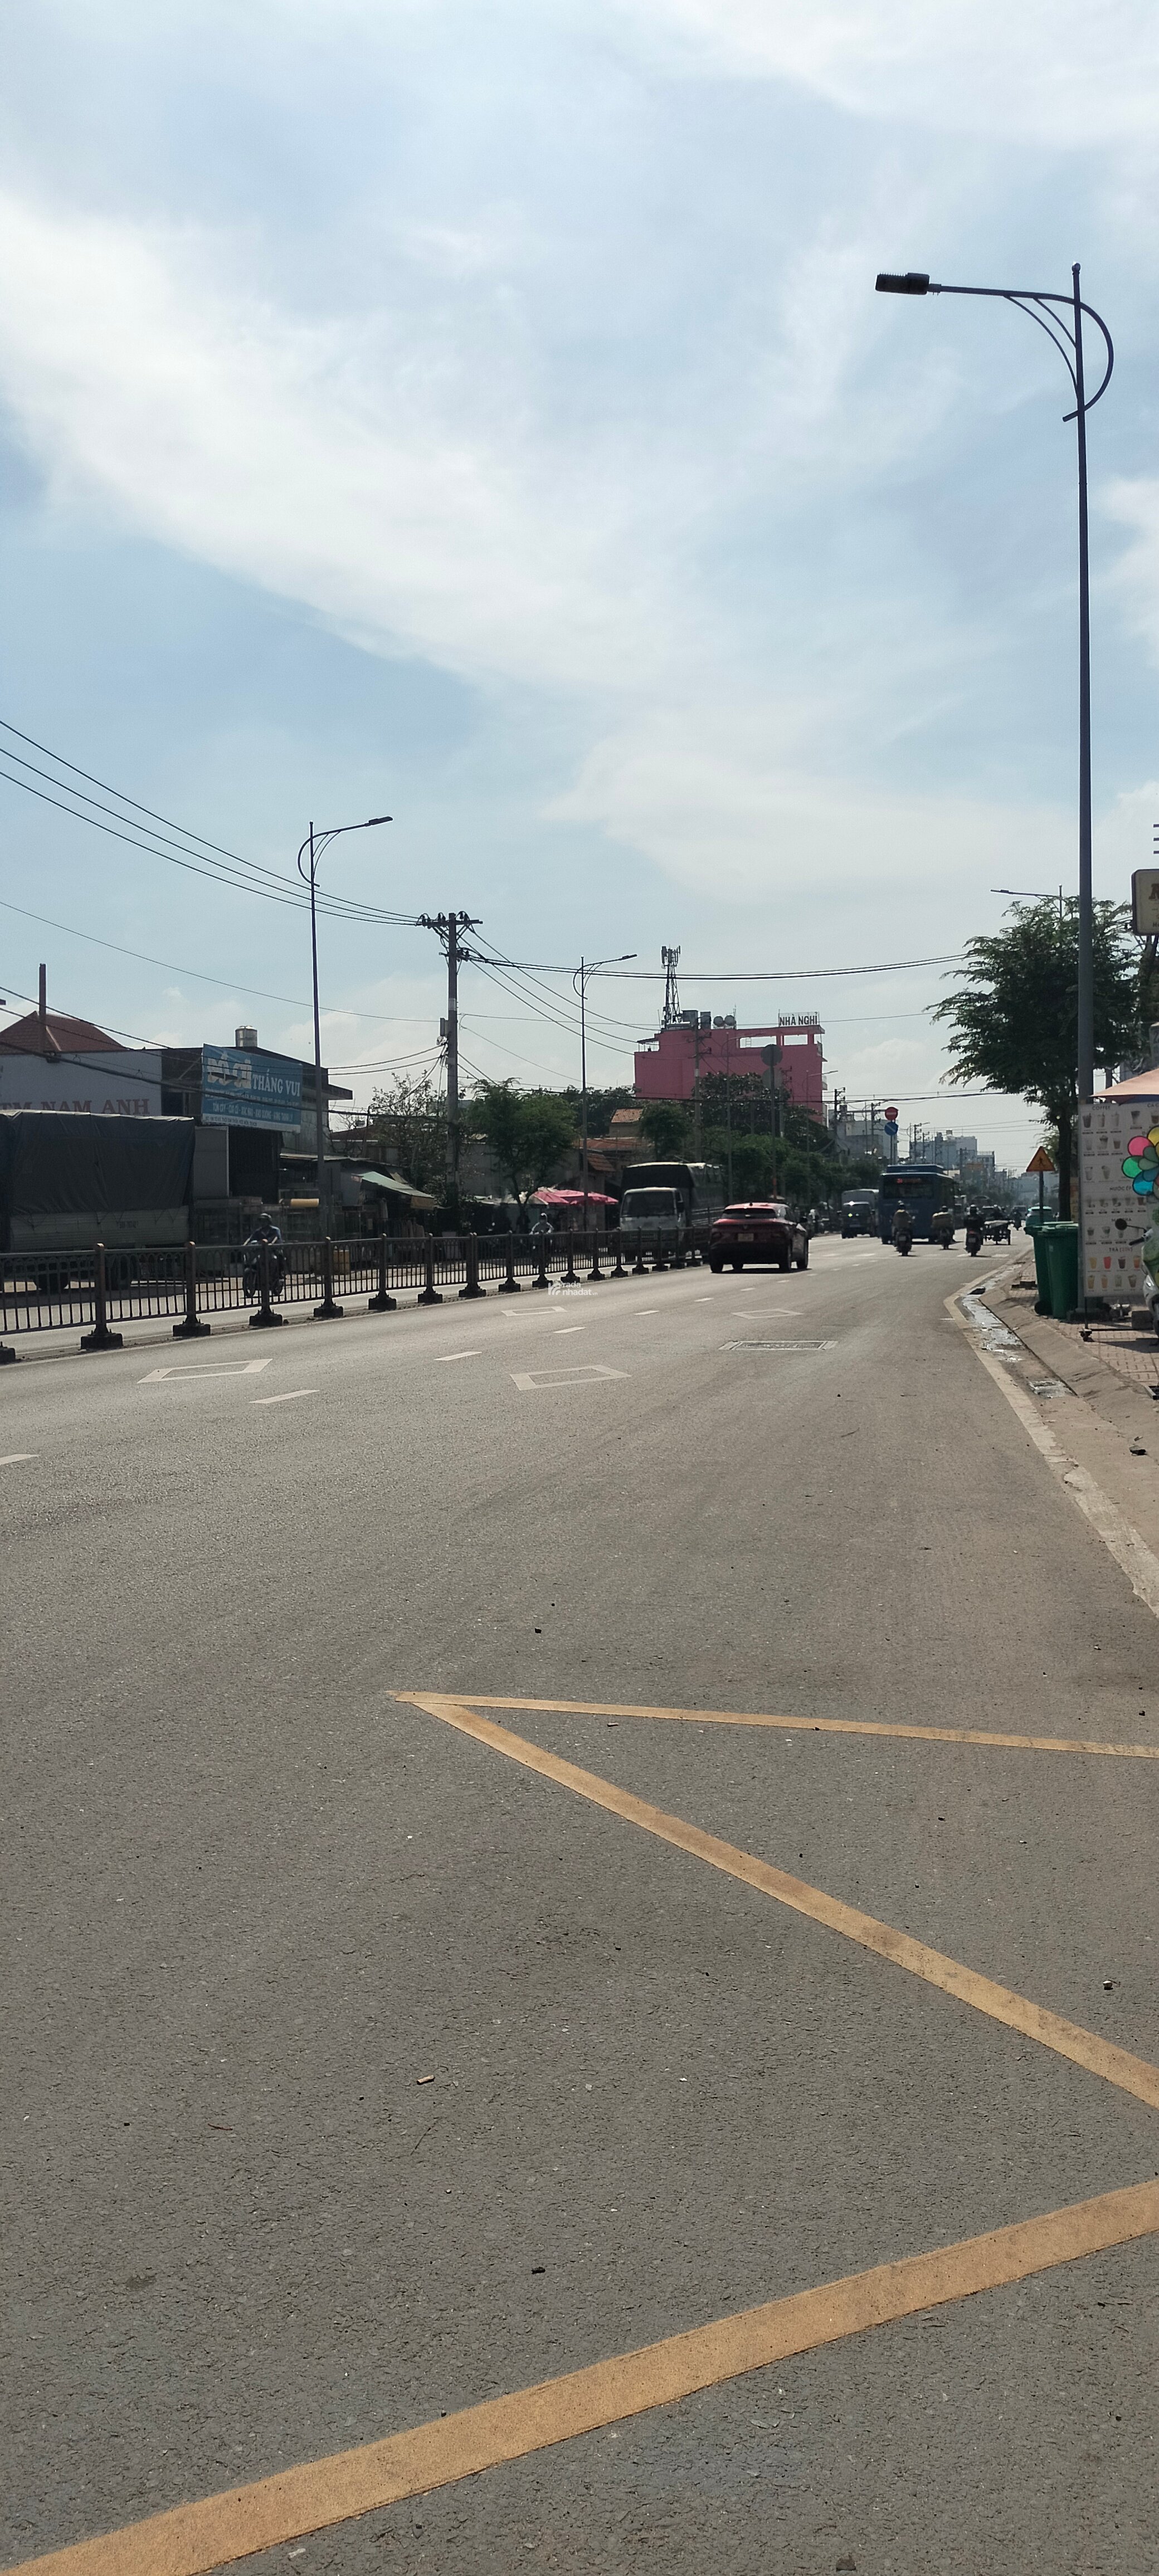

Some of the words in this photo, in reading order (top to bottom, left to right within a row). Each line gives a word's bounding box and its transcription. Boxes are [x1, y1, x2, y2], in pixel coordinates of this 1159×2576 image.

[780, 1014, 796, 1026] NHÀ
[798, 1012, 817, 1025] NGHỈ
[285, 1080, 300, 1096] VUI
[103, 1099, 150, 1115] ANH
